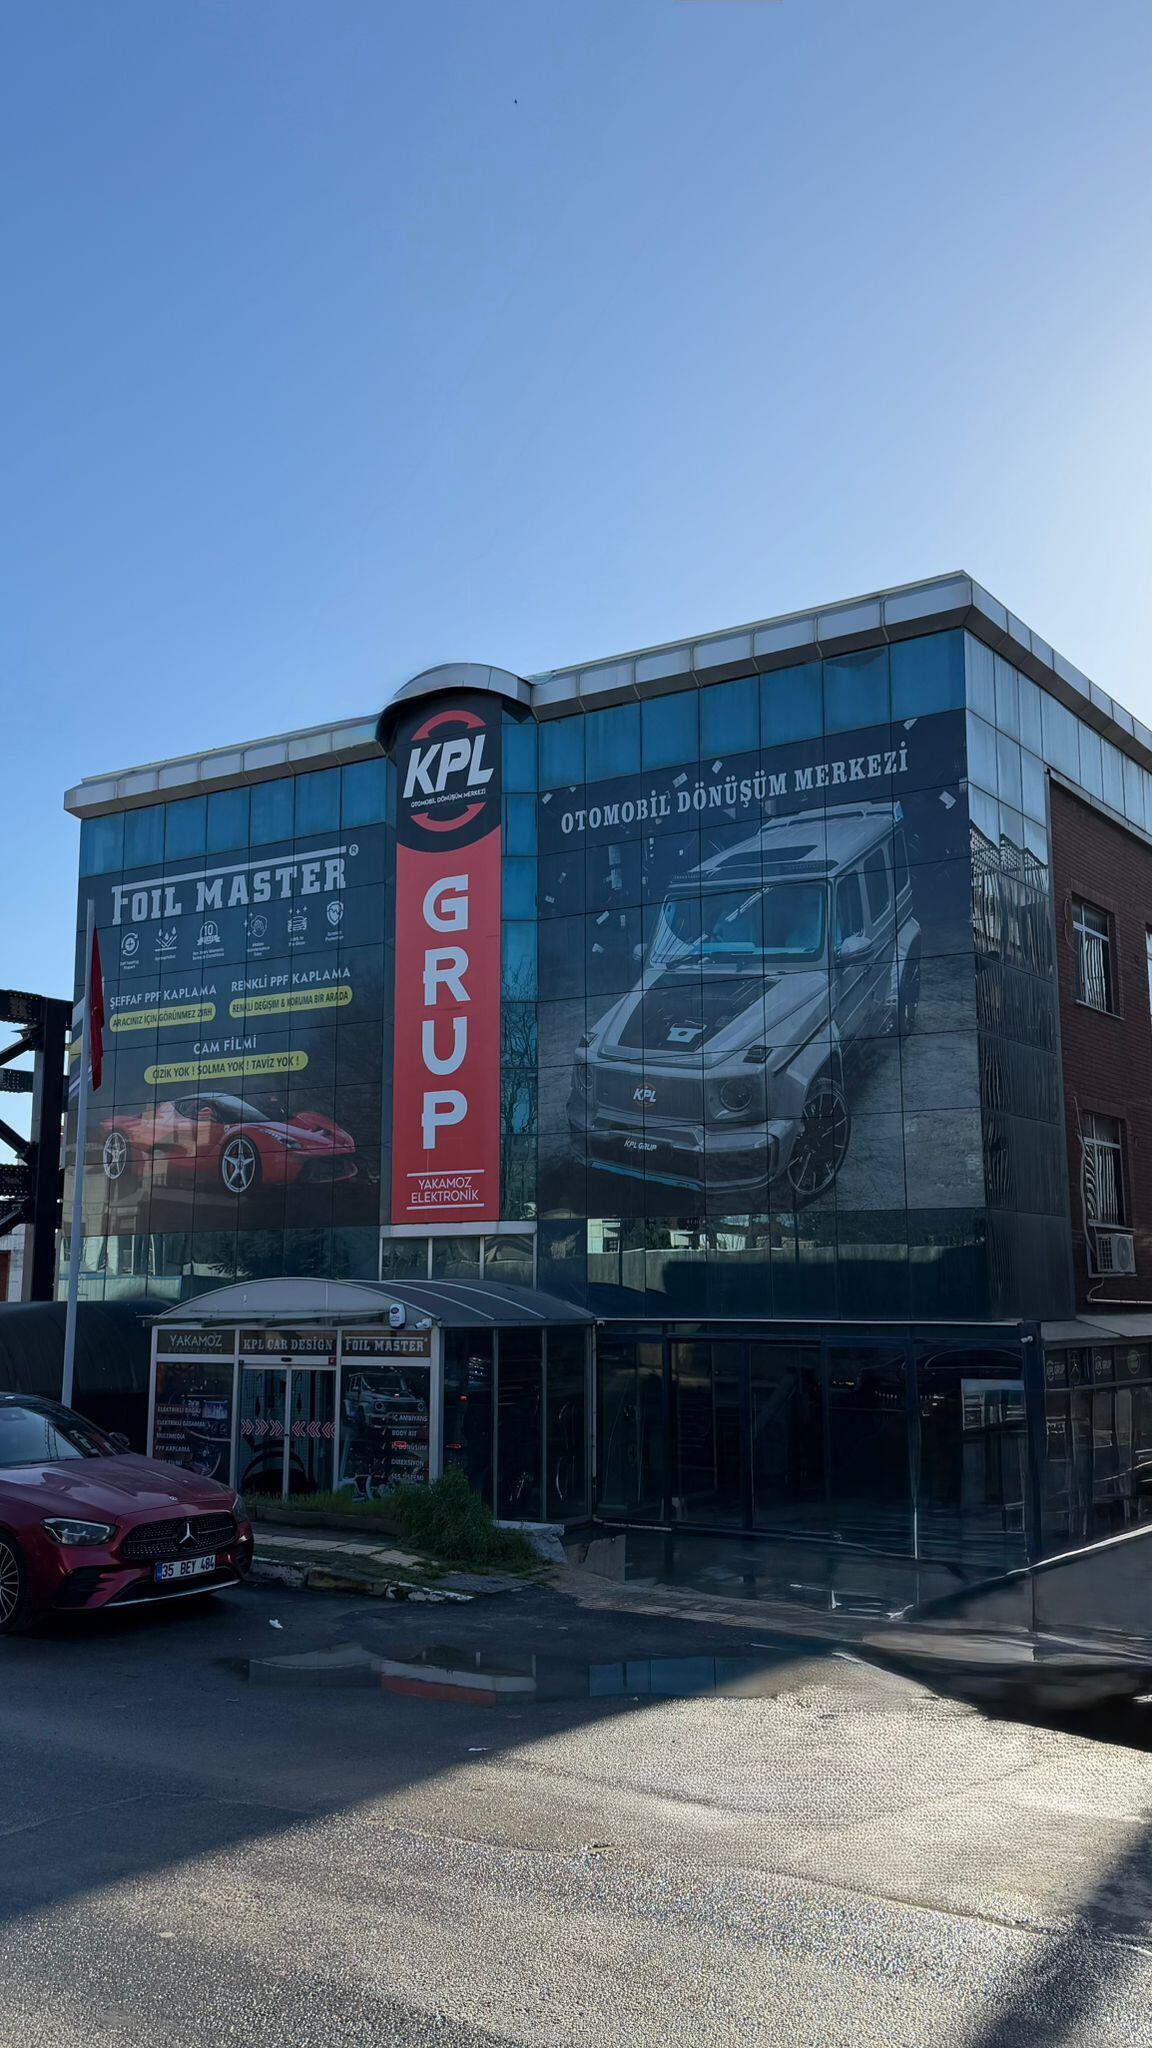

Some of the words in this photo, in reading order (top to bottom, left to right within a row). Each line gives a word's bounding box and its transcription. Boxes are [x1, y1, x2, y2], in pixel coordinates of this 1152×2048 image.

[403, 734, 494, 799] KPL
[561, 789, 671, 834] OTOMOBİL
[677, 771, 787, 808] DÖNÜŞÜM
[794, 740, 908, 792] MERKEZİ
[112, 885, 182, 925] FOIL
[196, 858, 346, 912] MASTER
[231, 974, 267, 992] RENKLİ
[270, 975, 288, 987] PPF
[292, 967, 351, 984] KAPLAMA
[110, 993, 142, 1009] ŞEFFAF
[145, 991, 161, 1003] PPF
[163, 984, 217, 1000] KAPLAMA
[422, 874, 471, 1149] GRUP
[193, 1041, 220, 1054] CAM
[224, 1034, 257, 1052] FİLMİ
[173, 1066, 189, 1077] YOK
[197, 1063, 225, 1075] SOLMA
[228, 1060, 244, 1072] YOK
[277, 1055, 293, 1067] YOK
[633, 1087, 656, 1103] KPL
[624, 1139, 637, 1149] KPL
[418, 1177, 472, 1190] YAKAMOZ
[411, 1188, 479, 1203] ELEKTRONİK
[170, 1335, 222, 1347] YAKAMOZ
[243, 1339, 264, 1350] KPL
[266, 1339, 288, 1350] CAR
[345, 1338, 371, 1351] FOIL
[374, 1340, 424, 1352] MASTER
[162, 1563, 174, 1577] 35
[180, 1559, 197, 1575] BEY
[200, 1556, 215, 1571] 484
